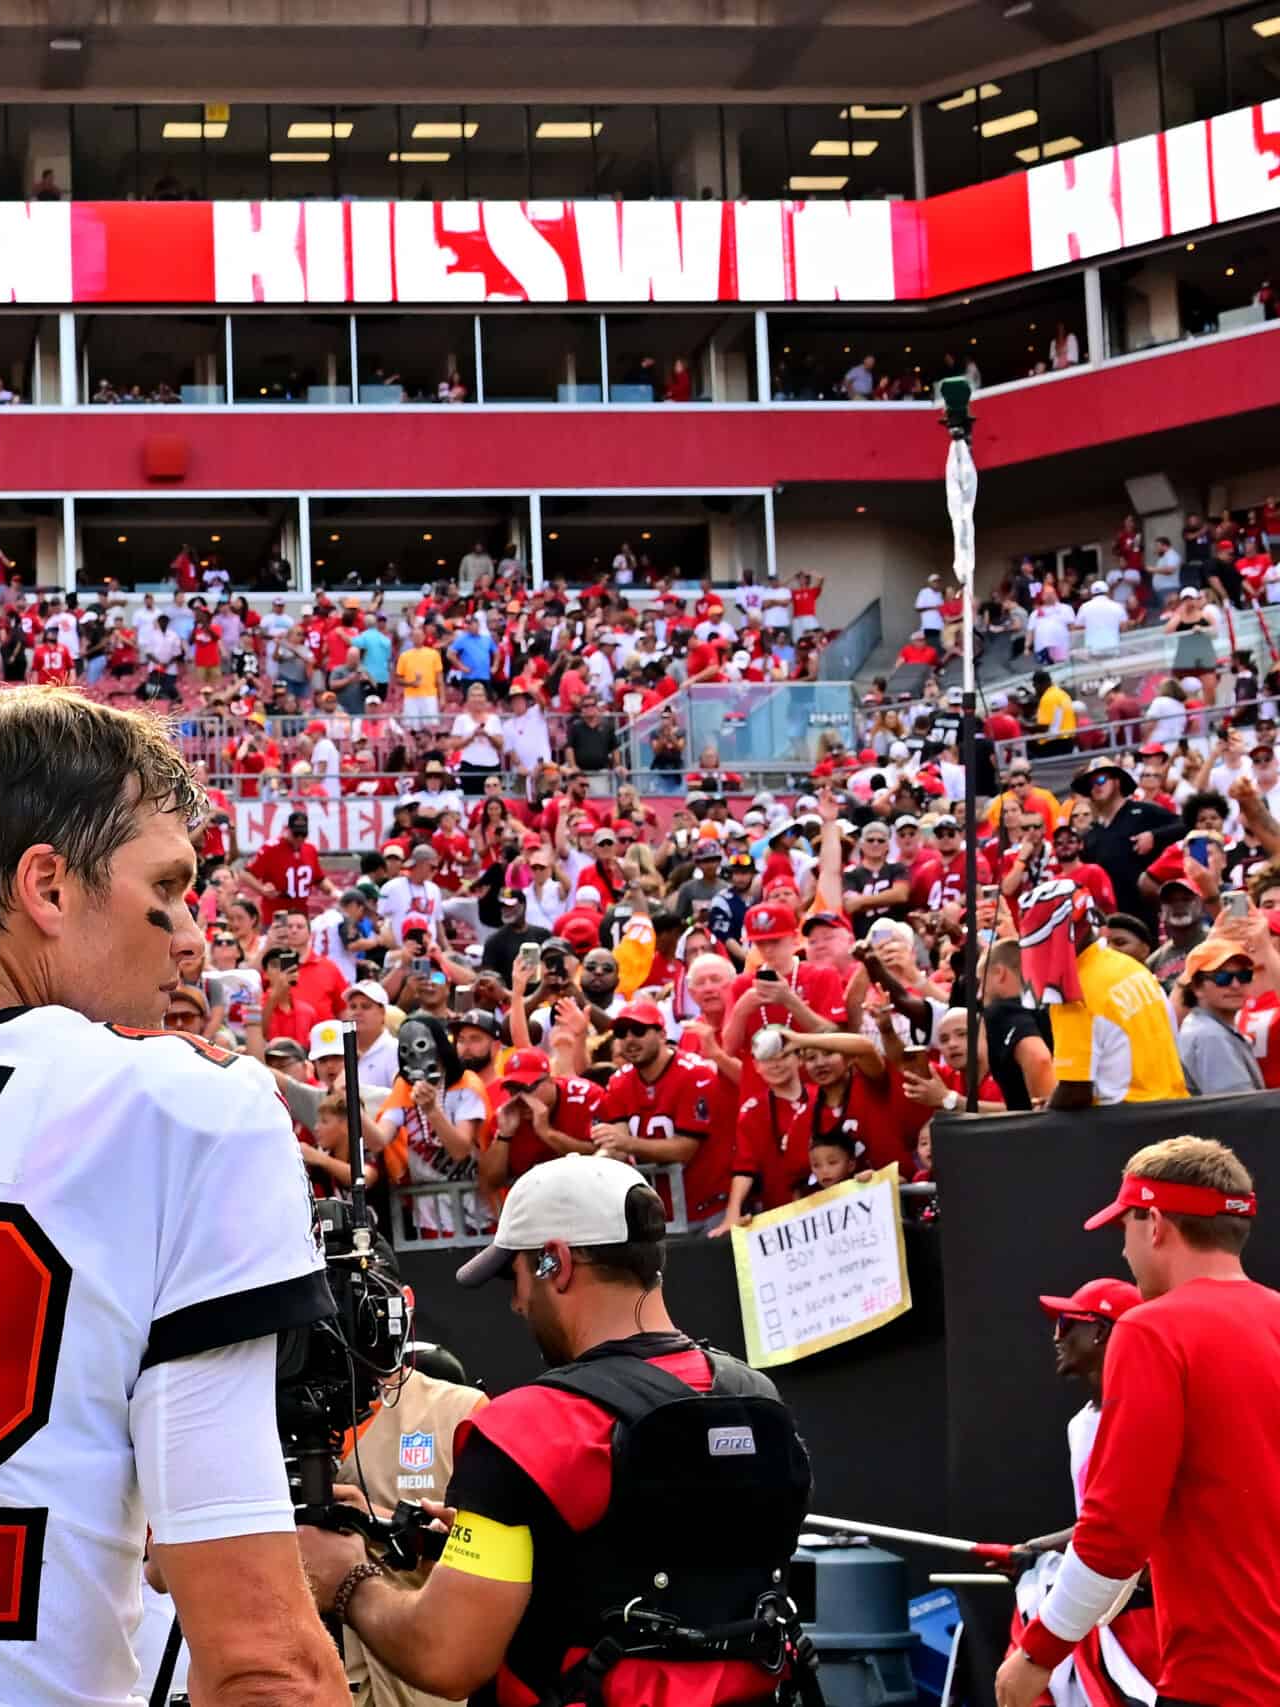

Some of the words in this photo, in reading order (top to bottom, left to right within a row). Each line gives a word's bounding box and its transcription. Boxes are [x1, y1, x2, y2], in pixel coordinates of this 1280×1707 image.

[285, 867, 313, 899] 12
[927, 873, 961, 911] 45
[758, 1199, 875, 1257] BIRTHDAY
[404, 1448, 429, 1465] NFL
[397, 1474, 434, 1489] MEDIA
[463, 1528, 473, 1544] 5
